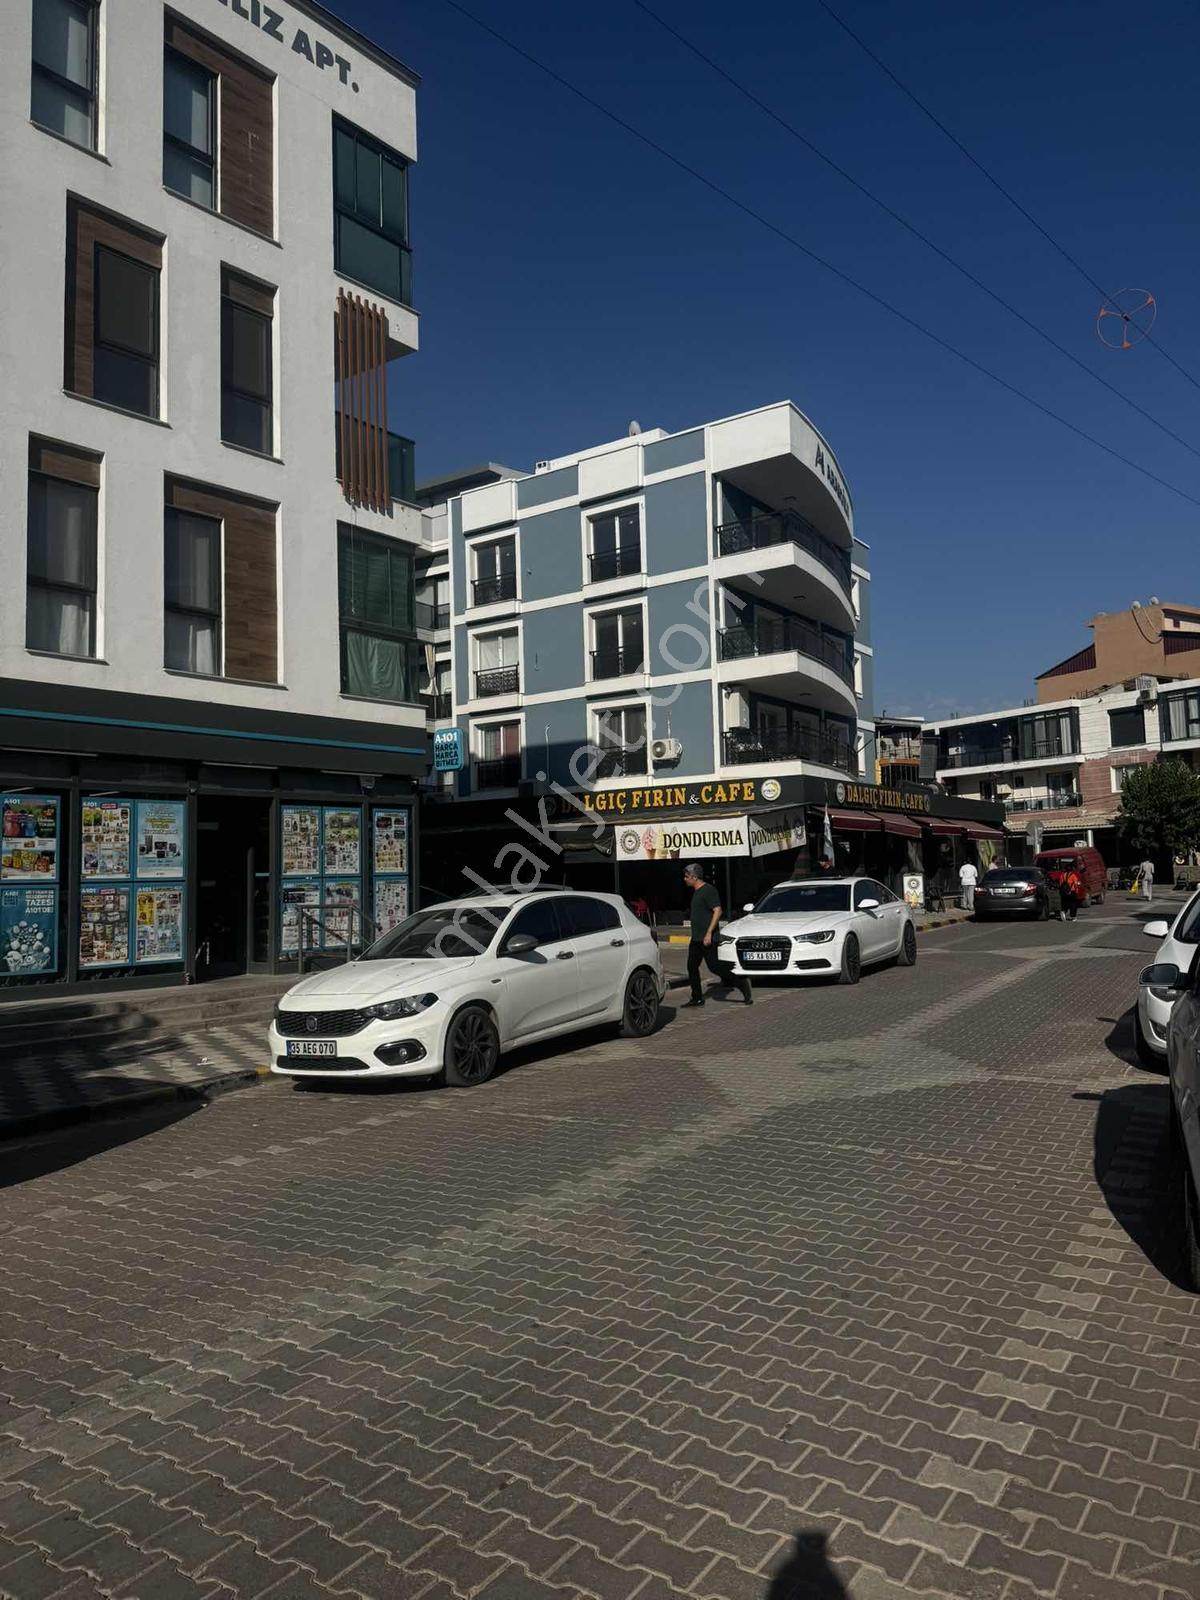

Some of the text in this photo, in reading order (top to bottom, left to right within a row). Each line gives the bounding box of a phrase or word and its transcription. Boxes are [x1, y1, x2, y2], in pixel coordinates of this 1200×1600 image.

[291, 29, 360, 93] APT.
[435, 743, 459, 752] HARCA
[435, 751, 459, 760] HARCA
[632, 787, 687, 809] FIRIN
[688, 793, 701, 805] &
[700, 781, 755, 804] CAFE
[663, 830, 744, 849] DONDURMA
[291, 1043, 334, 1054] 35 AEG 070
